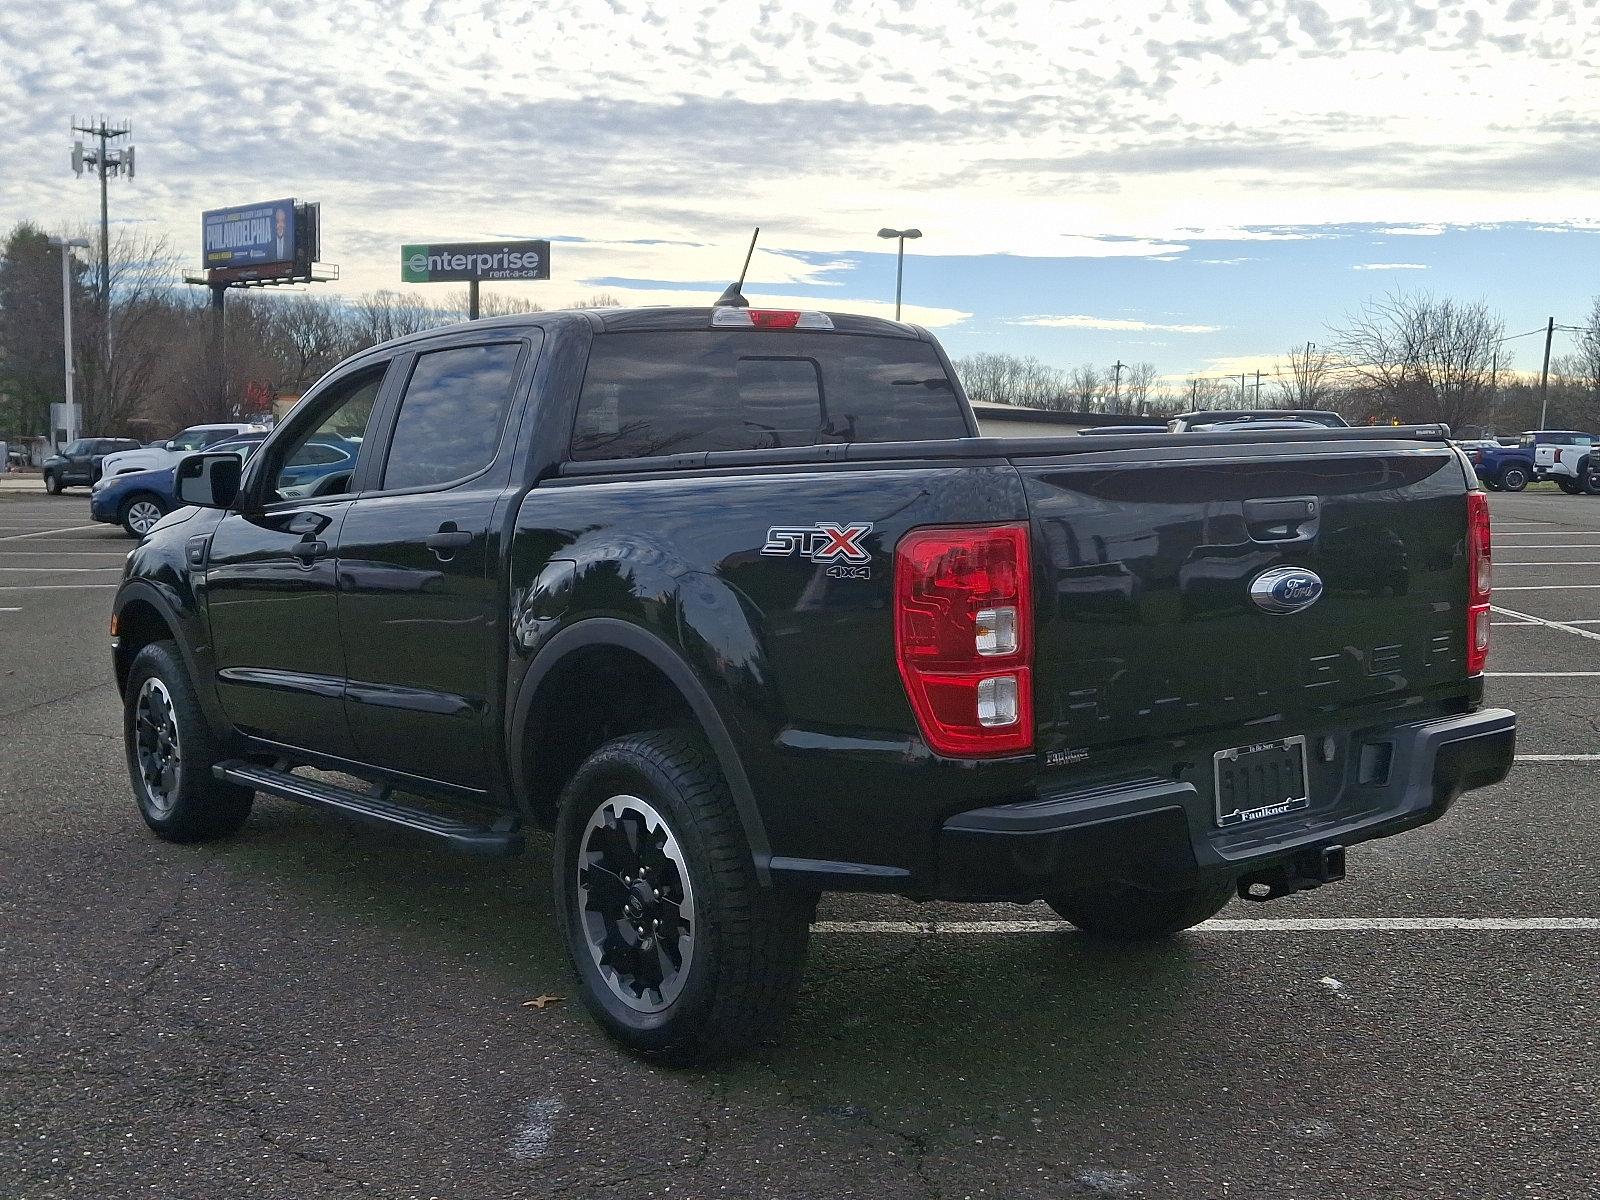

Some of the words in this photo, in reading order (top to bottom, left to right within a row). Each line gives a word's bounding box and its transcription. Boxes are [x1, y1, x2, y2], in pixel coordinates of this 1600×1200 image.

[409, 248, 539, 275] enterprise
[489, 269, 538, 278] rent-a-car
[760, 522, 873, 564] STX
[1284, 579, 1313, 598] Ford
[1054, 630, 1457, 727] RGER
[1241, 804, 1290, 821] Faulkner
